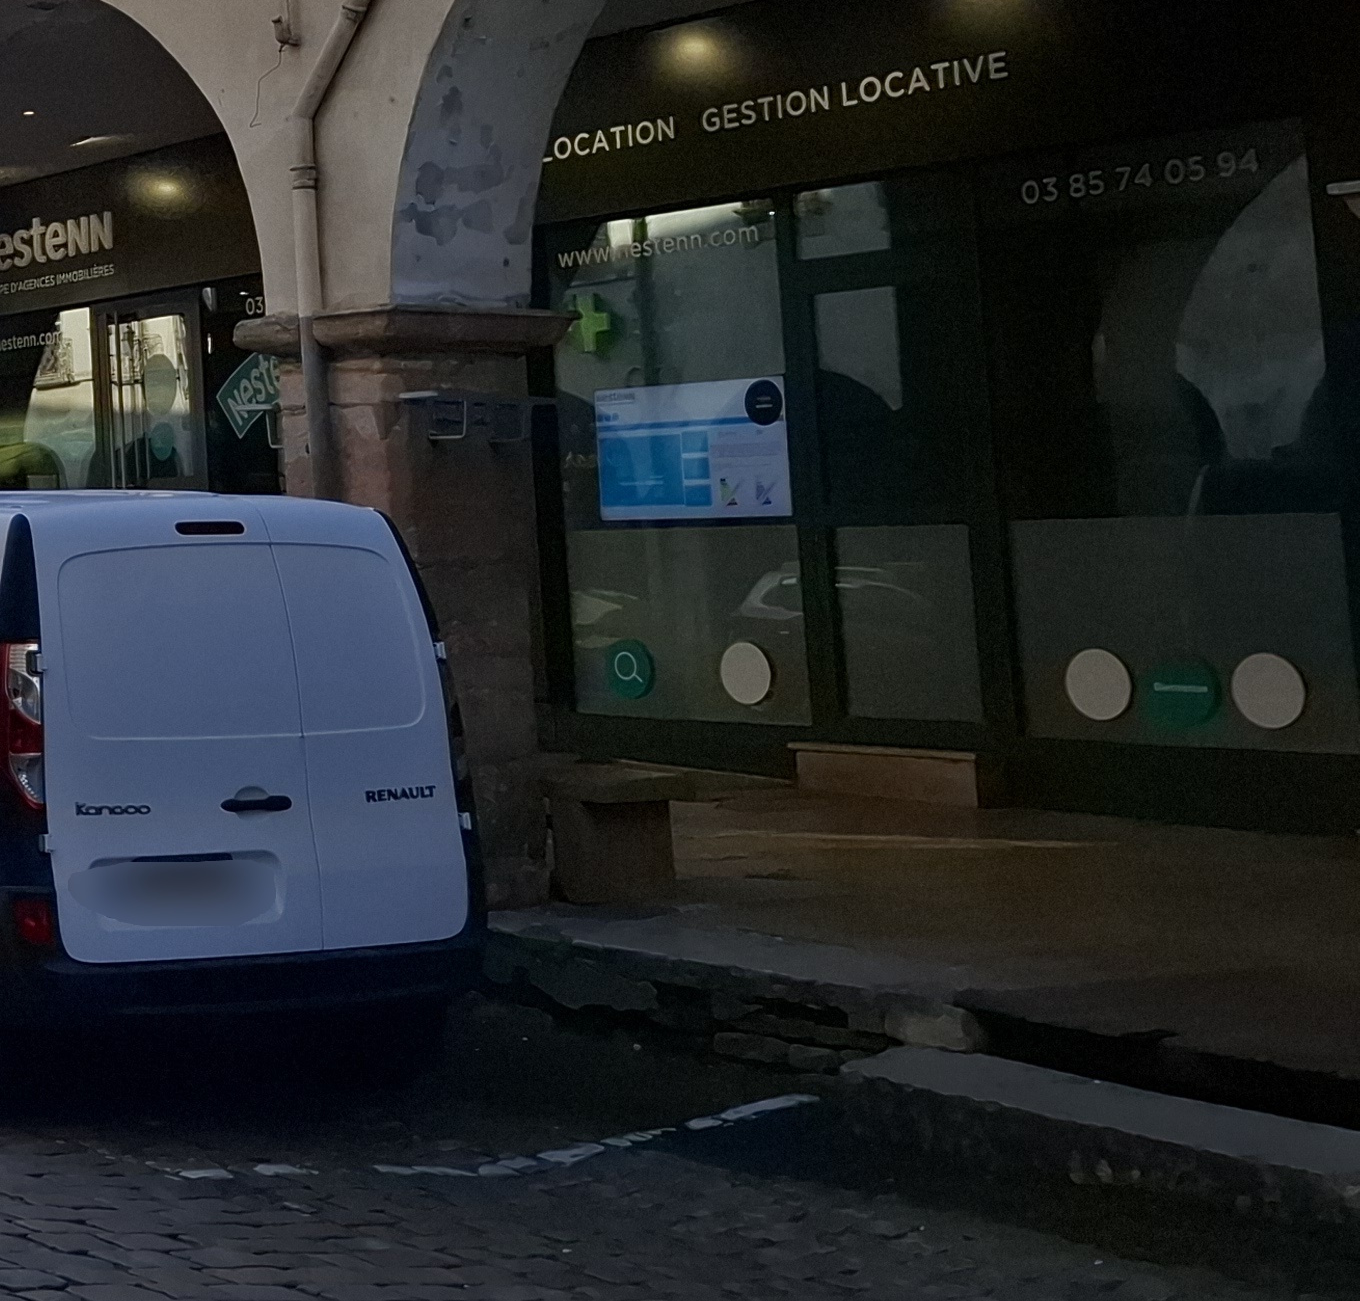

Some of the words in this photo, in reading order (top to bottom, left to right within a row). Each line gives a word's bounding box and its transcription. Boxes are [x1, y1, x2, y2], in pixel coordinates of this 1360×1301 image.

[542, 115, 676, 164] OCATION
[701, 84, 831, 134] GESTION
[840, 50, 1010, 107] LOCATIVE
[1020, 176, 1060, 205] 03
[1068, 170, 1106, 199] 85
[1114, 163, 1155, 192] 74
[1163, 155, 1207, 186] 05
[1215, 148, 1260, 179] 94
[245, 296, 264, 316] 03
[365, 785, 436, 803] RENAULT
